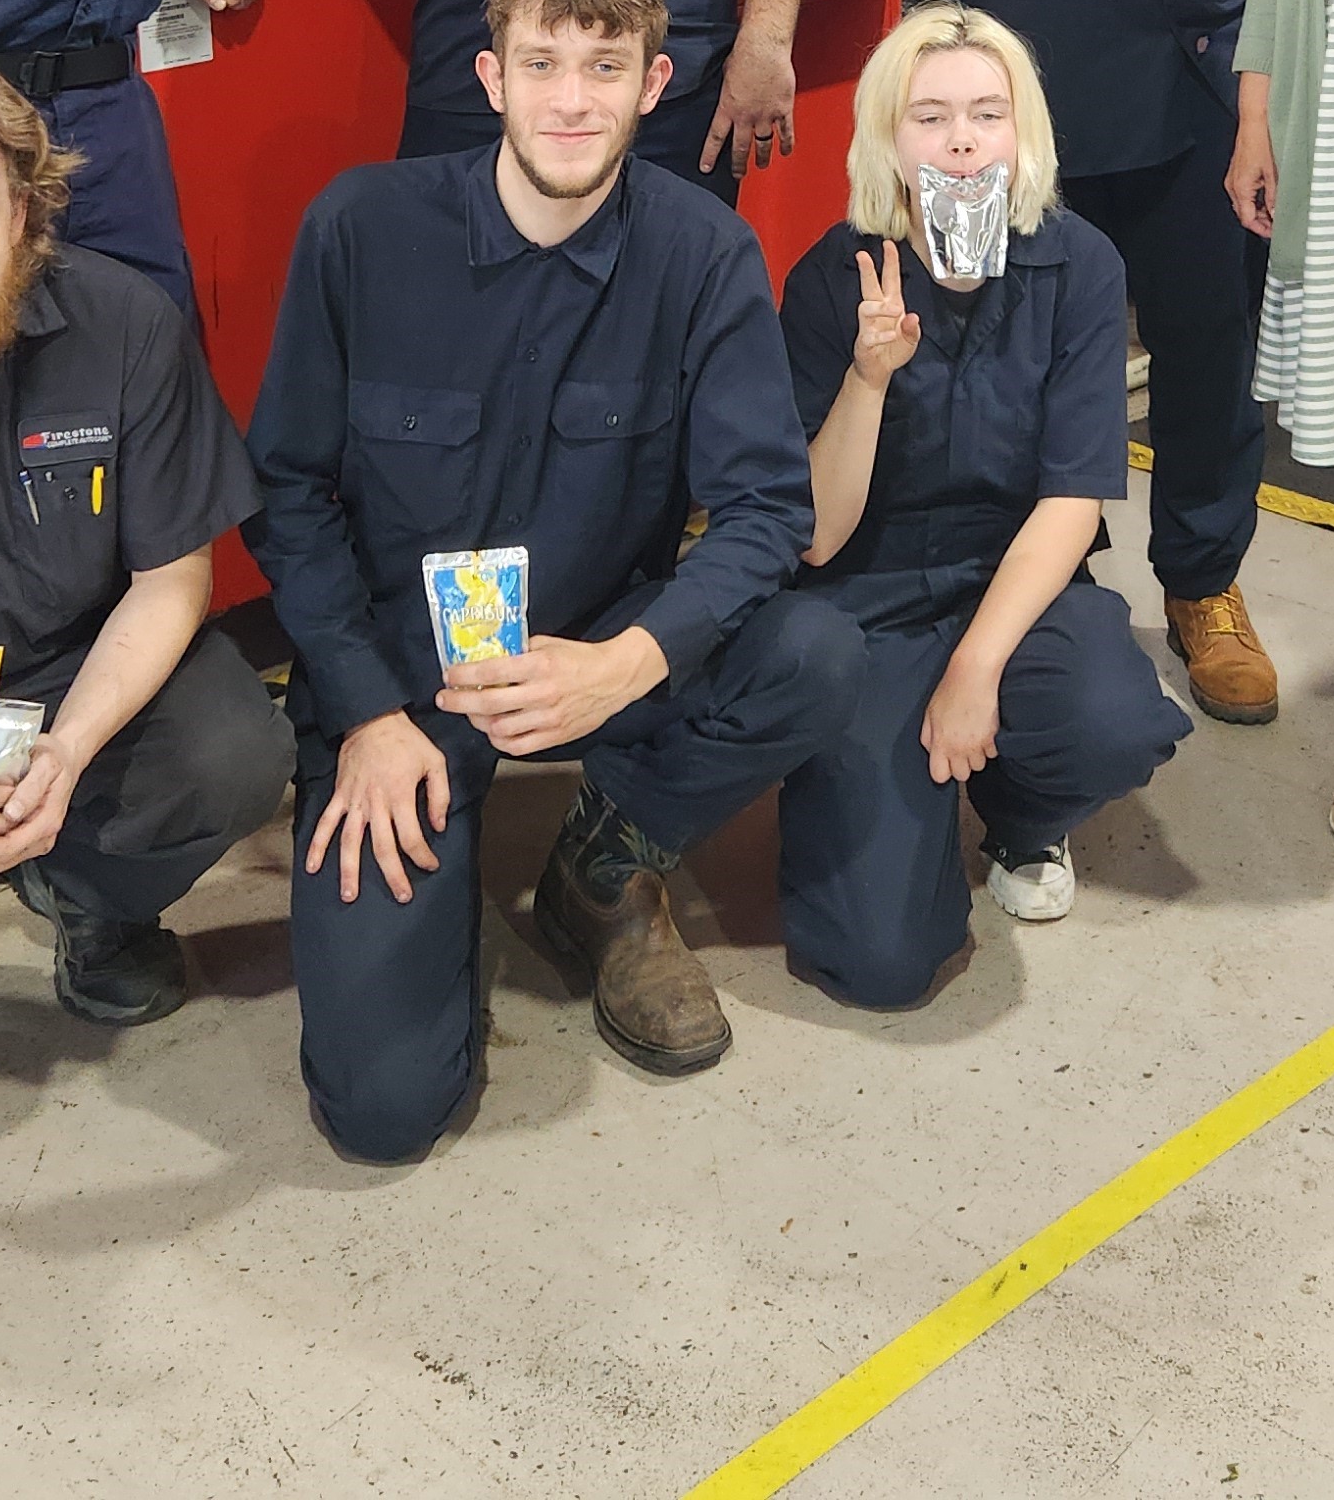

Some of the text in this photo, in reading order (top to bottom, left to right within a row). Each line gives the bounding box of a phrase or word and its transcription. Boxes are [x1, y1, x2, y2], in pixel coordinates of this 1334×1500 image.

[40, 426, 110, 444] Firestone
[442, 603, 521, 625] CAPRI SUN
